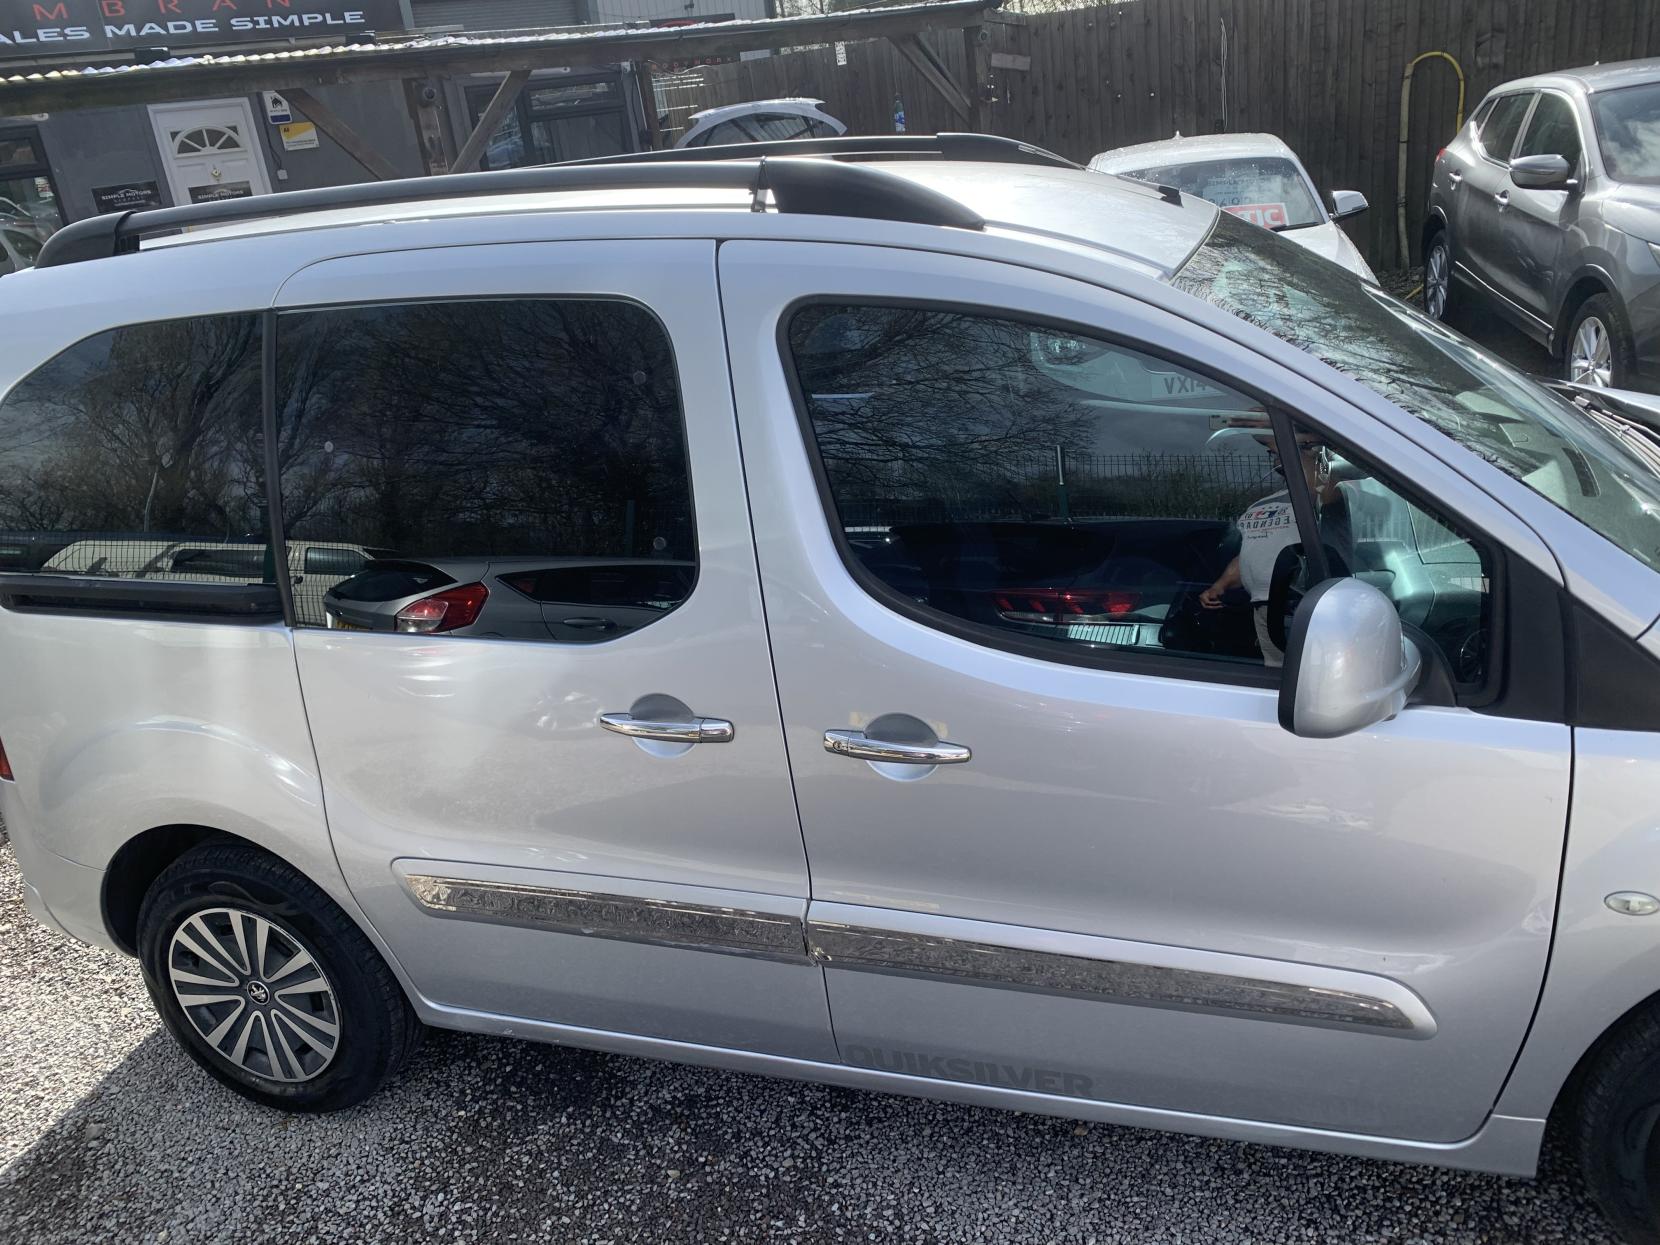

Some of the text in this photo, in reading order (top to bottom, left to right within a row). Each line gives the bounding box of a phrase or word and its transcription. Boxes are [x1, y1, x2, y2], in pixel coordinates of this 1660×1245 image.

[104, 19, 219, 38] MADE
[230, 11, 366, 30] SIMPLE
[844, 1043, 1094, 1097] QUIKSILVER
